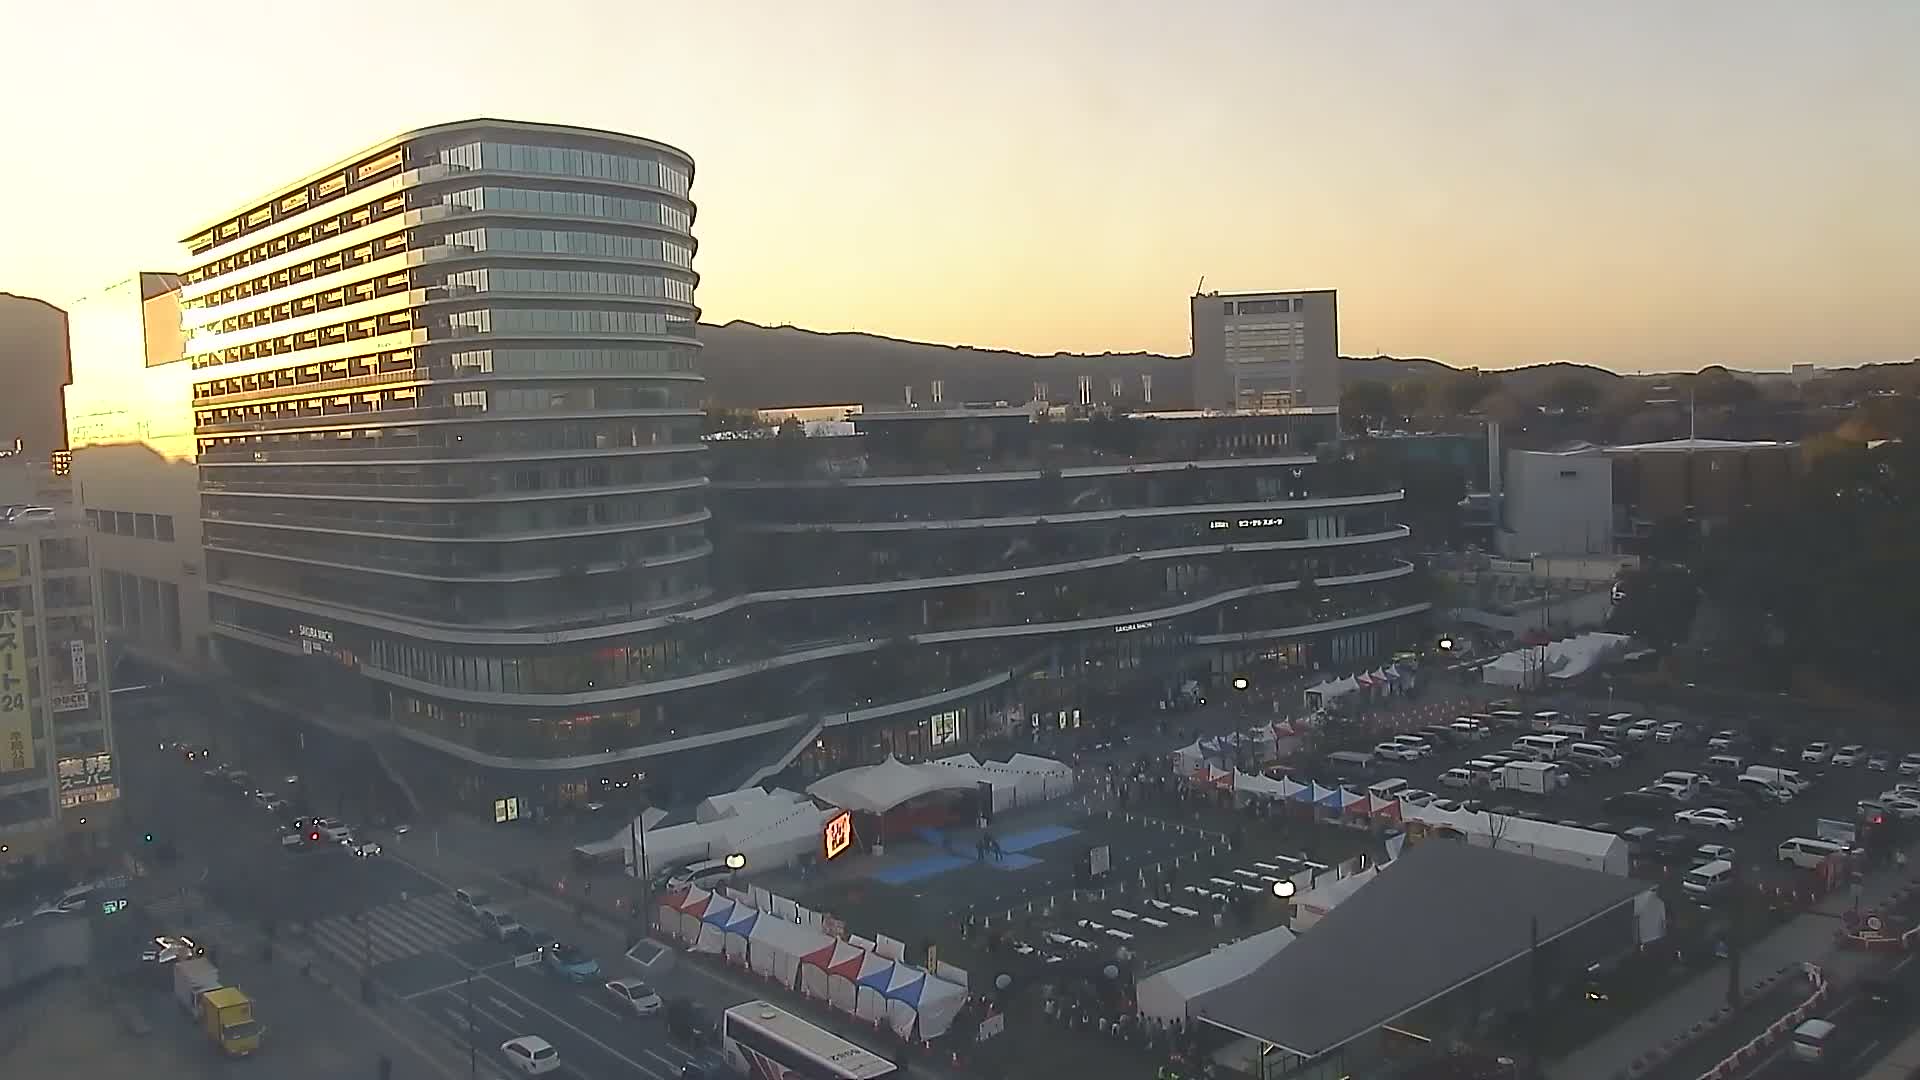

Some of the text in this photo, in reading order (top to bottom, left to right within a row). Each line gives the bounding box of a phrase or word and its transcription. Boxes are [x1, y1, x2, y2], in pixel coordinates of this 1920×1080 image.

[60, 774, 112, 790] スーパー
[119, 900, 127, 910] P
